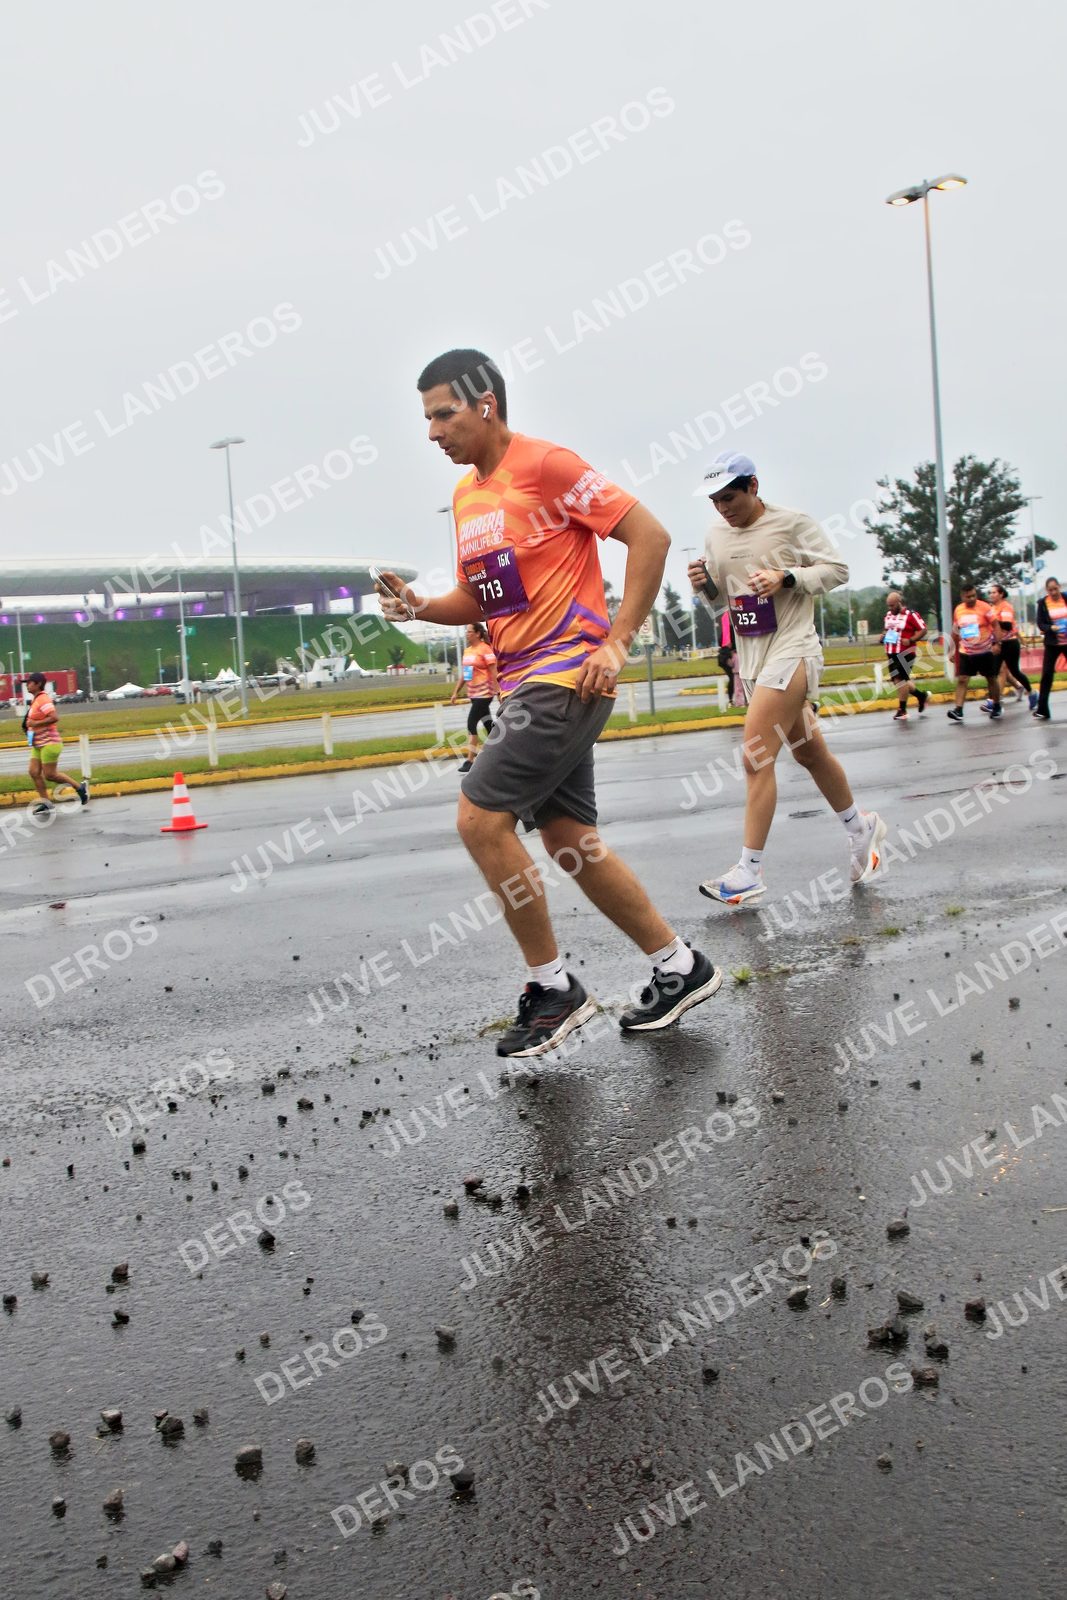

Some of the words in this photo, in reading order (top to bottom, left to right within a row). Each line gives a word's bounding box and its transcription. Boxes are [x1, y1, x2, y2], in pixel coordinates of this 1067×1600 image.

[497, 552, 511, 568] 15K
[479, 579, 503, 601] 713
[737, 612, 758, 625] 252
